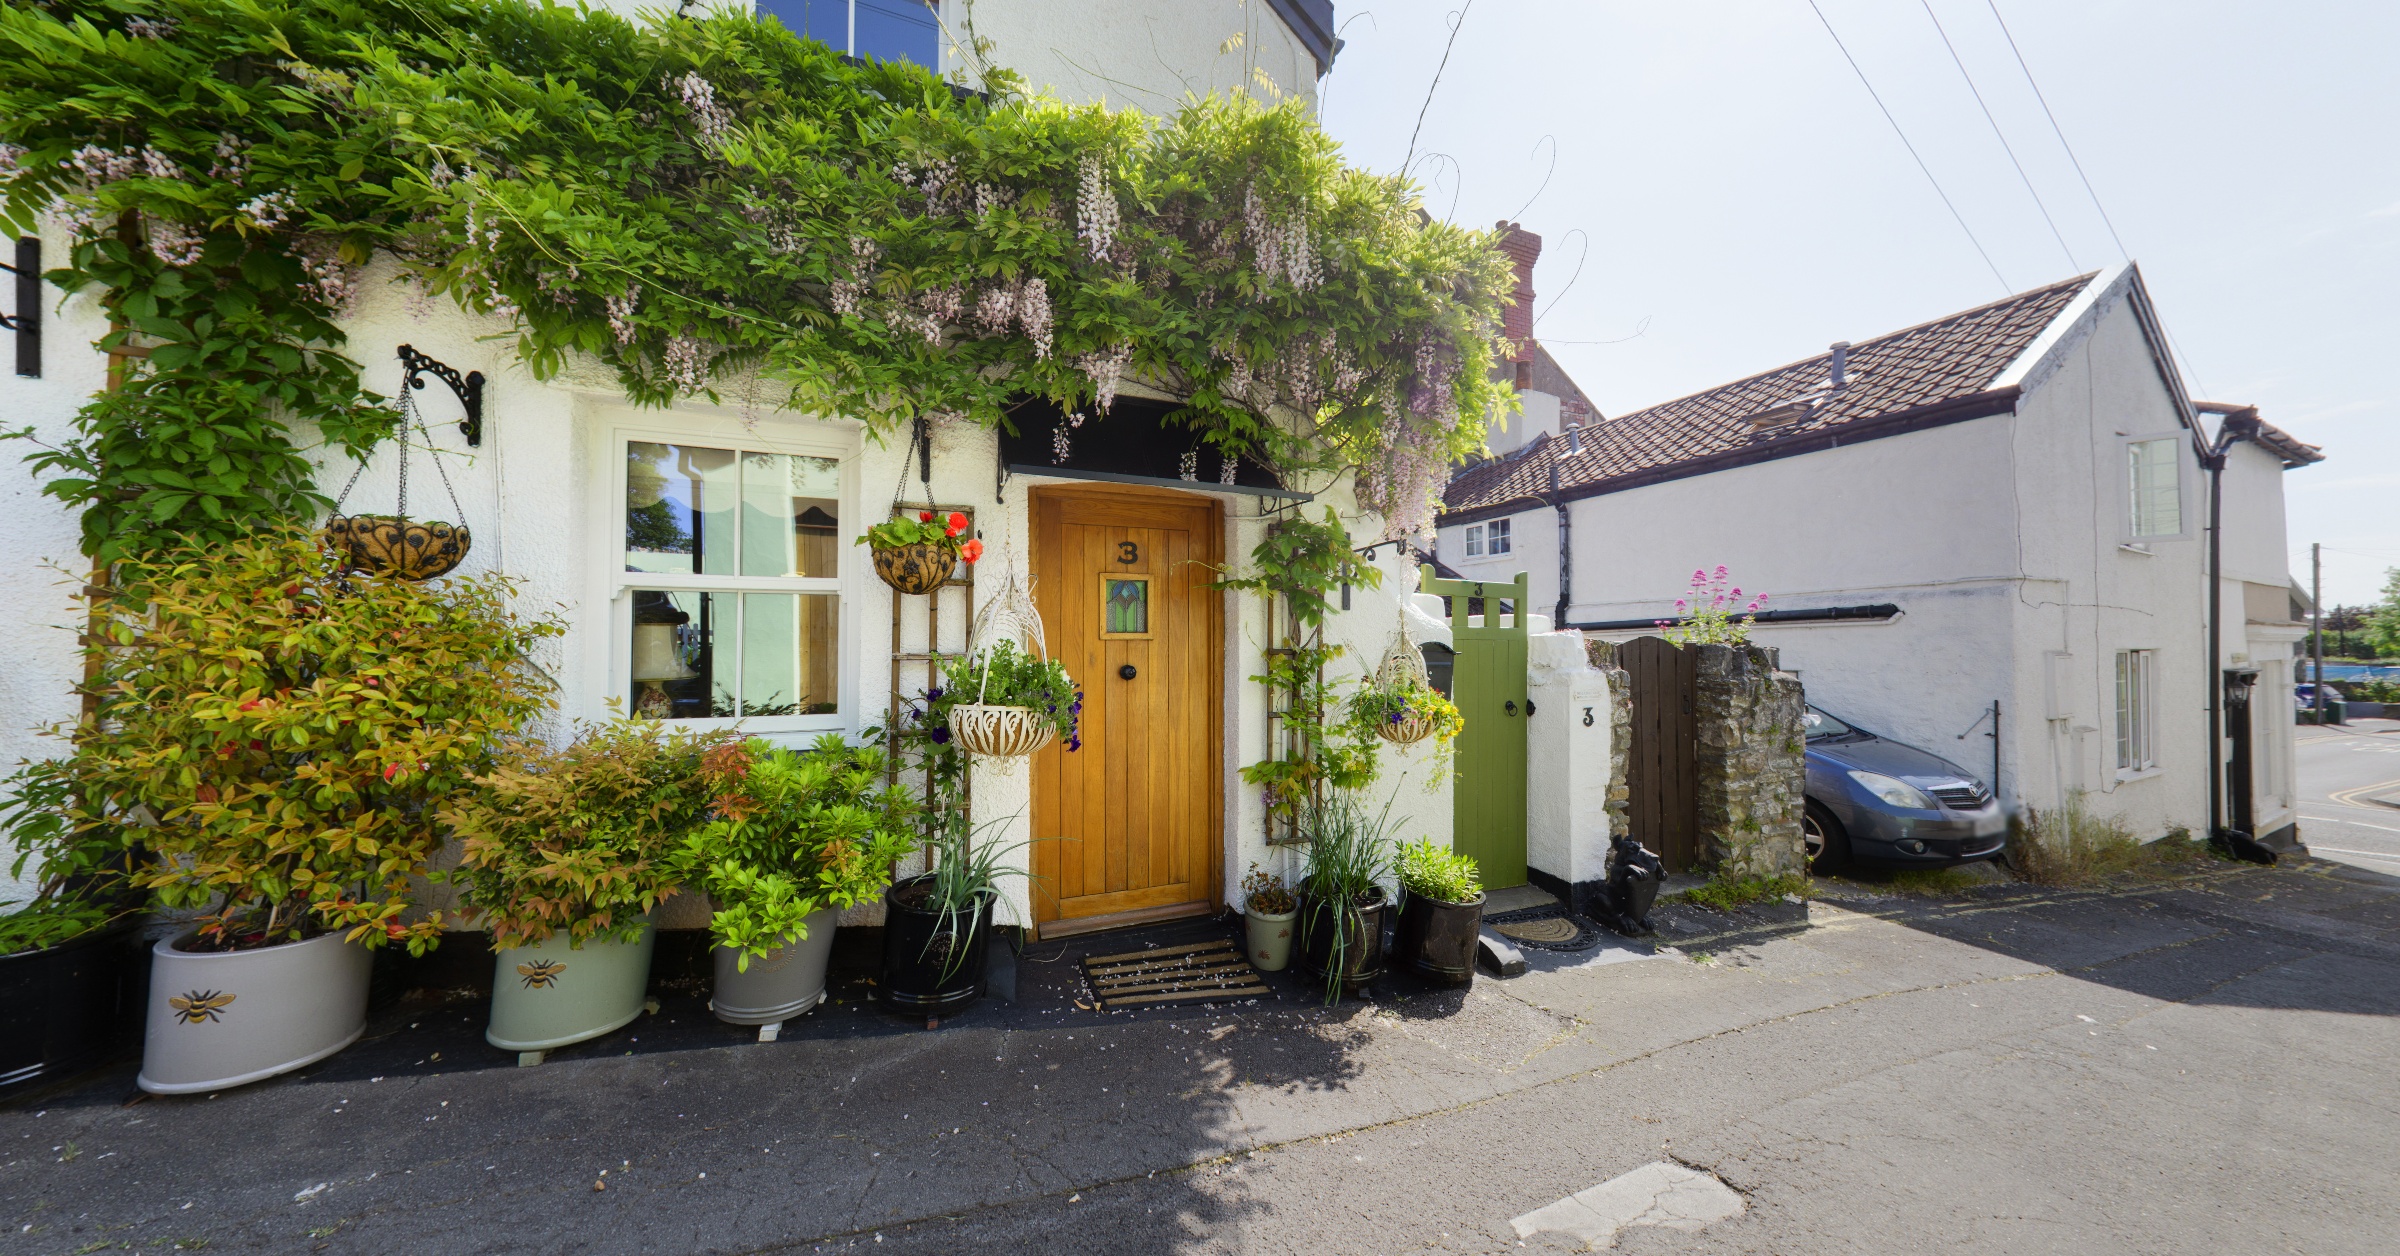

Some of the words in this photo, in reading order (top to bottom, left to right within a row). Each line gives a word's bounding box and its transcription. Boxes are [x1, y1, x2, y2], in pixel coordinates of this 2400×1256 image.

[1117, 541, 1138, 565] 3
[1474, 582, 1483, 596] 3
[1582, 706, 1595, 727] 3
